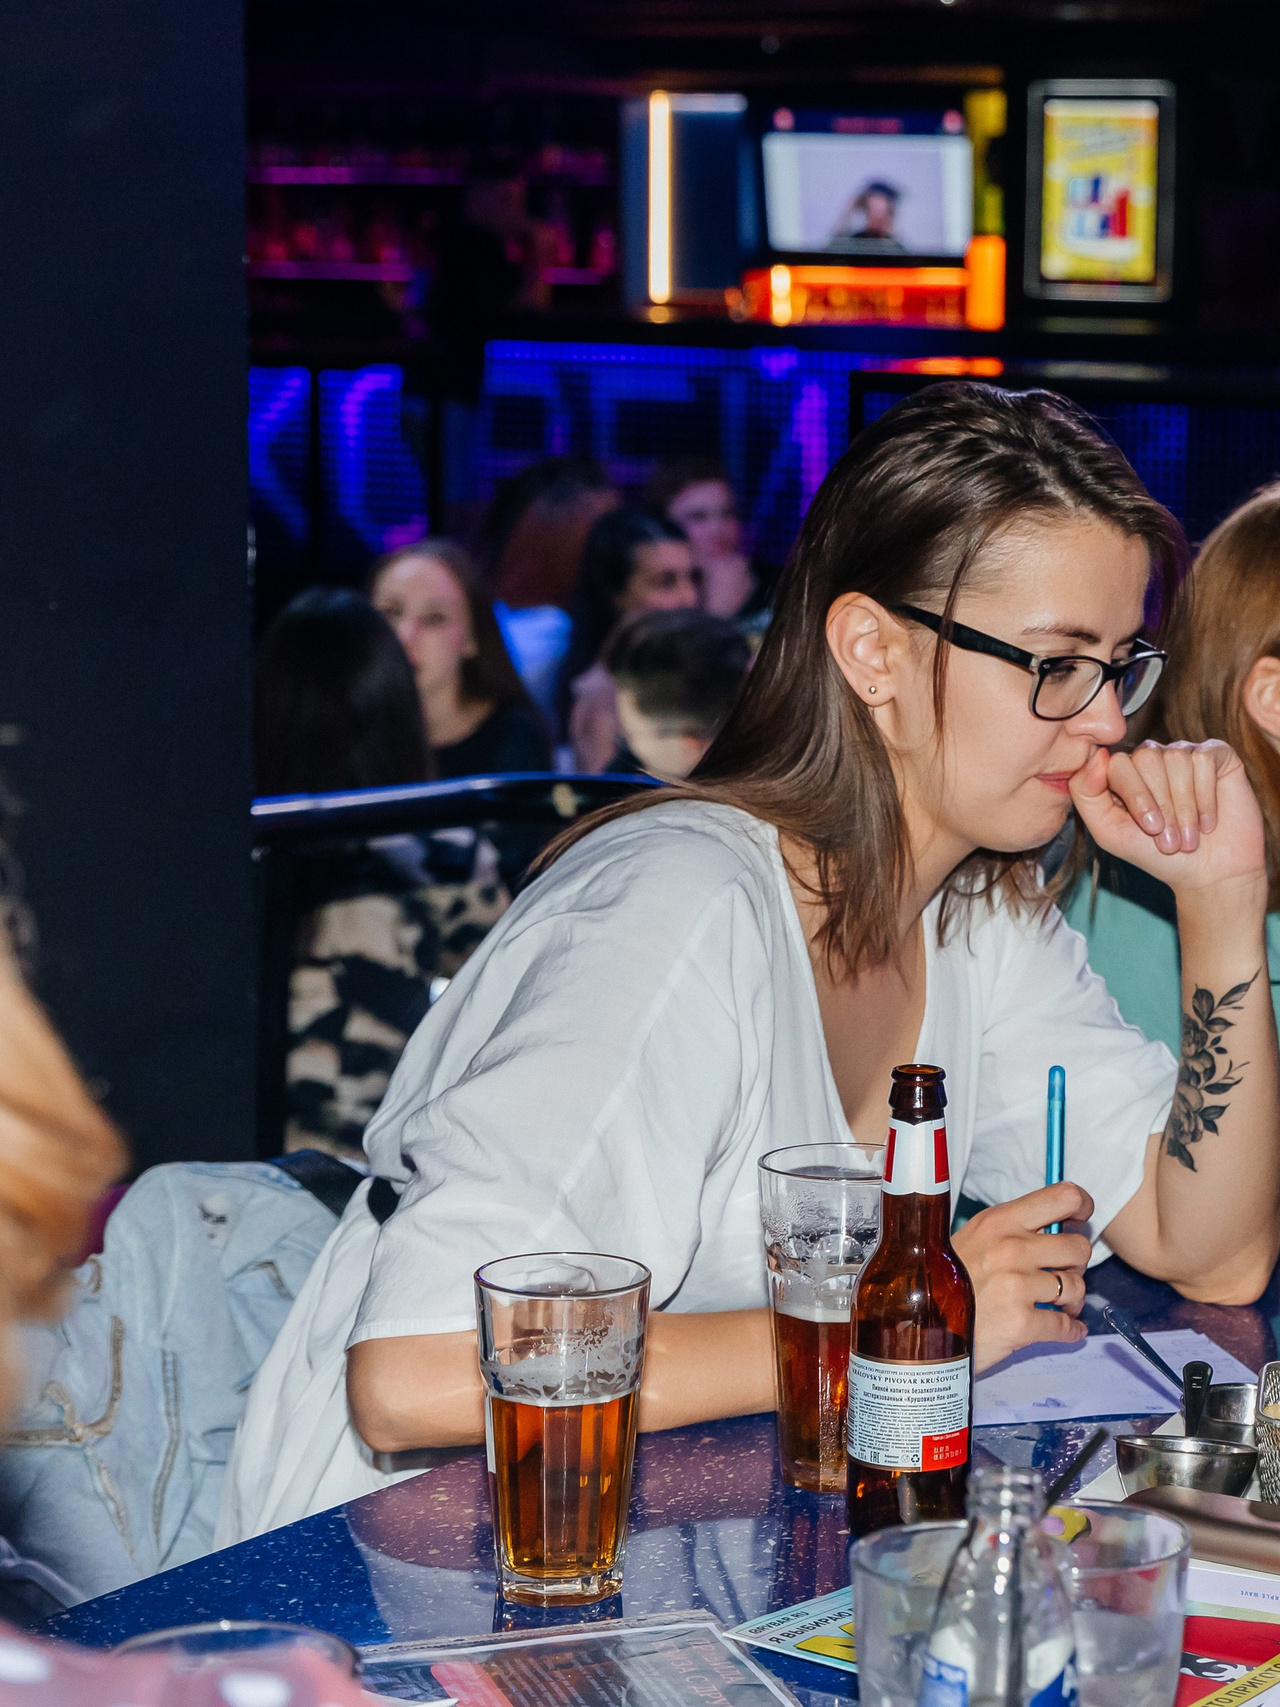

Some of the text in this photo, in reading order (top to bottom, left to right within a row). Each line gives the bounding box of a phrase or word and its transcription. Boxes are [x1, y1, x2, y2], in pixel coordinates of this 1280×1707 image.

[885, 1377, 918, 1385] PIVOVAR
[921, 1373, 959, 1385] KRUŠOVICE
[872, 1384, 952, 1394] Пивной напиток безалкогольный
[1240, 1590, 1259, 1598] WAVE
[782, 1611, 853, 1639] ВЫБИРАЮ
